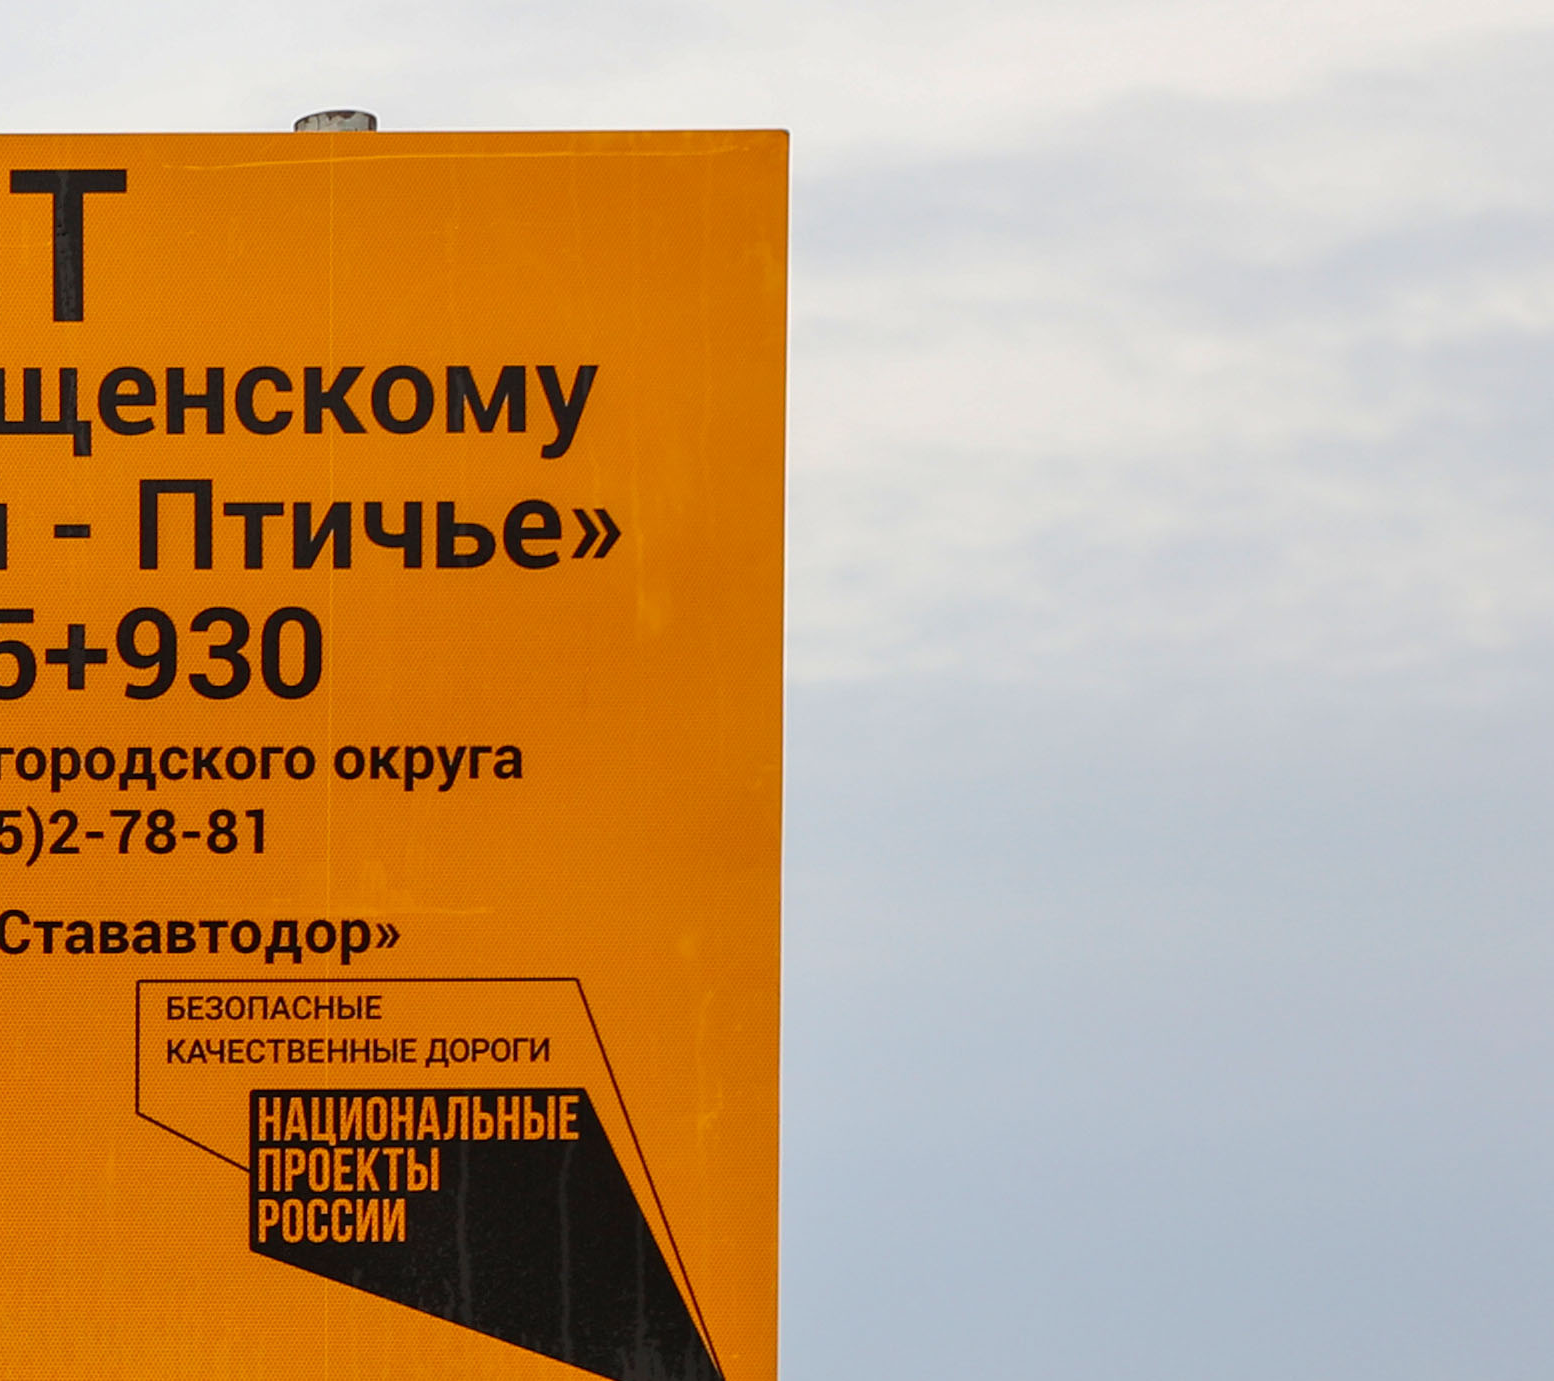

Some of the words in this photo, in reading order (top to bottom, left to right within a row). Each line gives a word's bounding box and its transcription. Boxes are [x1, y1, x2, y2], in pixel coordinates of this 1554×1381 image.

[55, 524, 90, 538] -
[139, 479, 622, 570] Птичье»
[334, 745, 523, 792] округа
[166, 995, 382, 1020] БЕЗОПАСНЫЕ
[166, 1038, 417, 1064] КАЧЕСТВЕННЫЕ
[424, 1037, 550, 1068] ДОРОГИ
[257, 1095, 580, 1144] НАЦИОНАЛЬНЫЕ
[257, 1147, 440, 1192] ПРОЕКТЫ
[257, 1198, 407, 1243] РОССИИ
